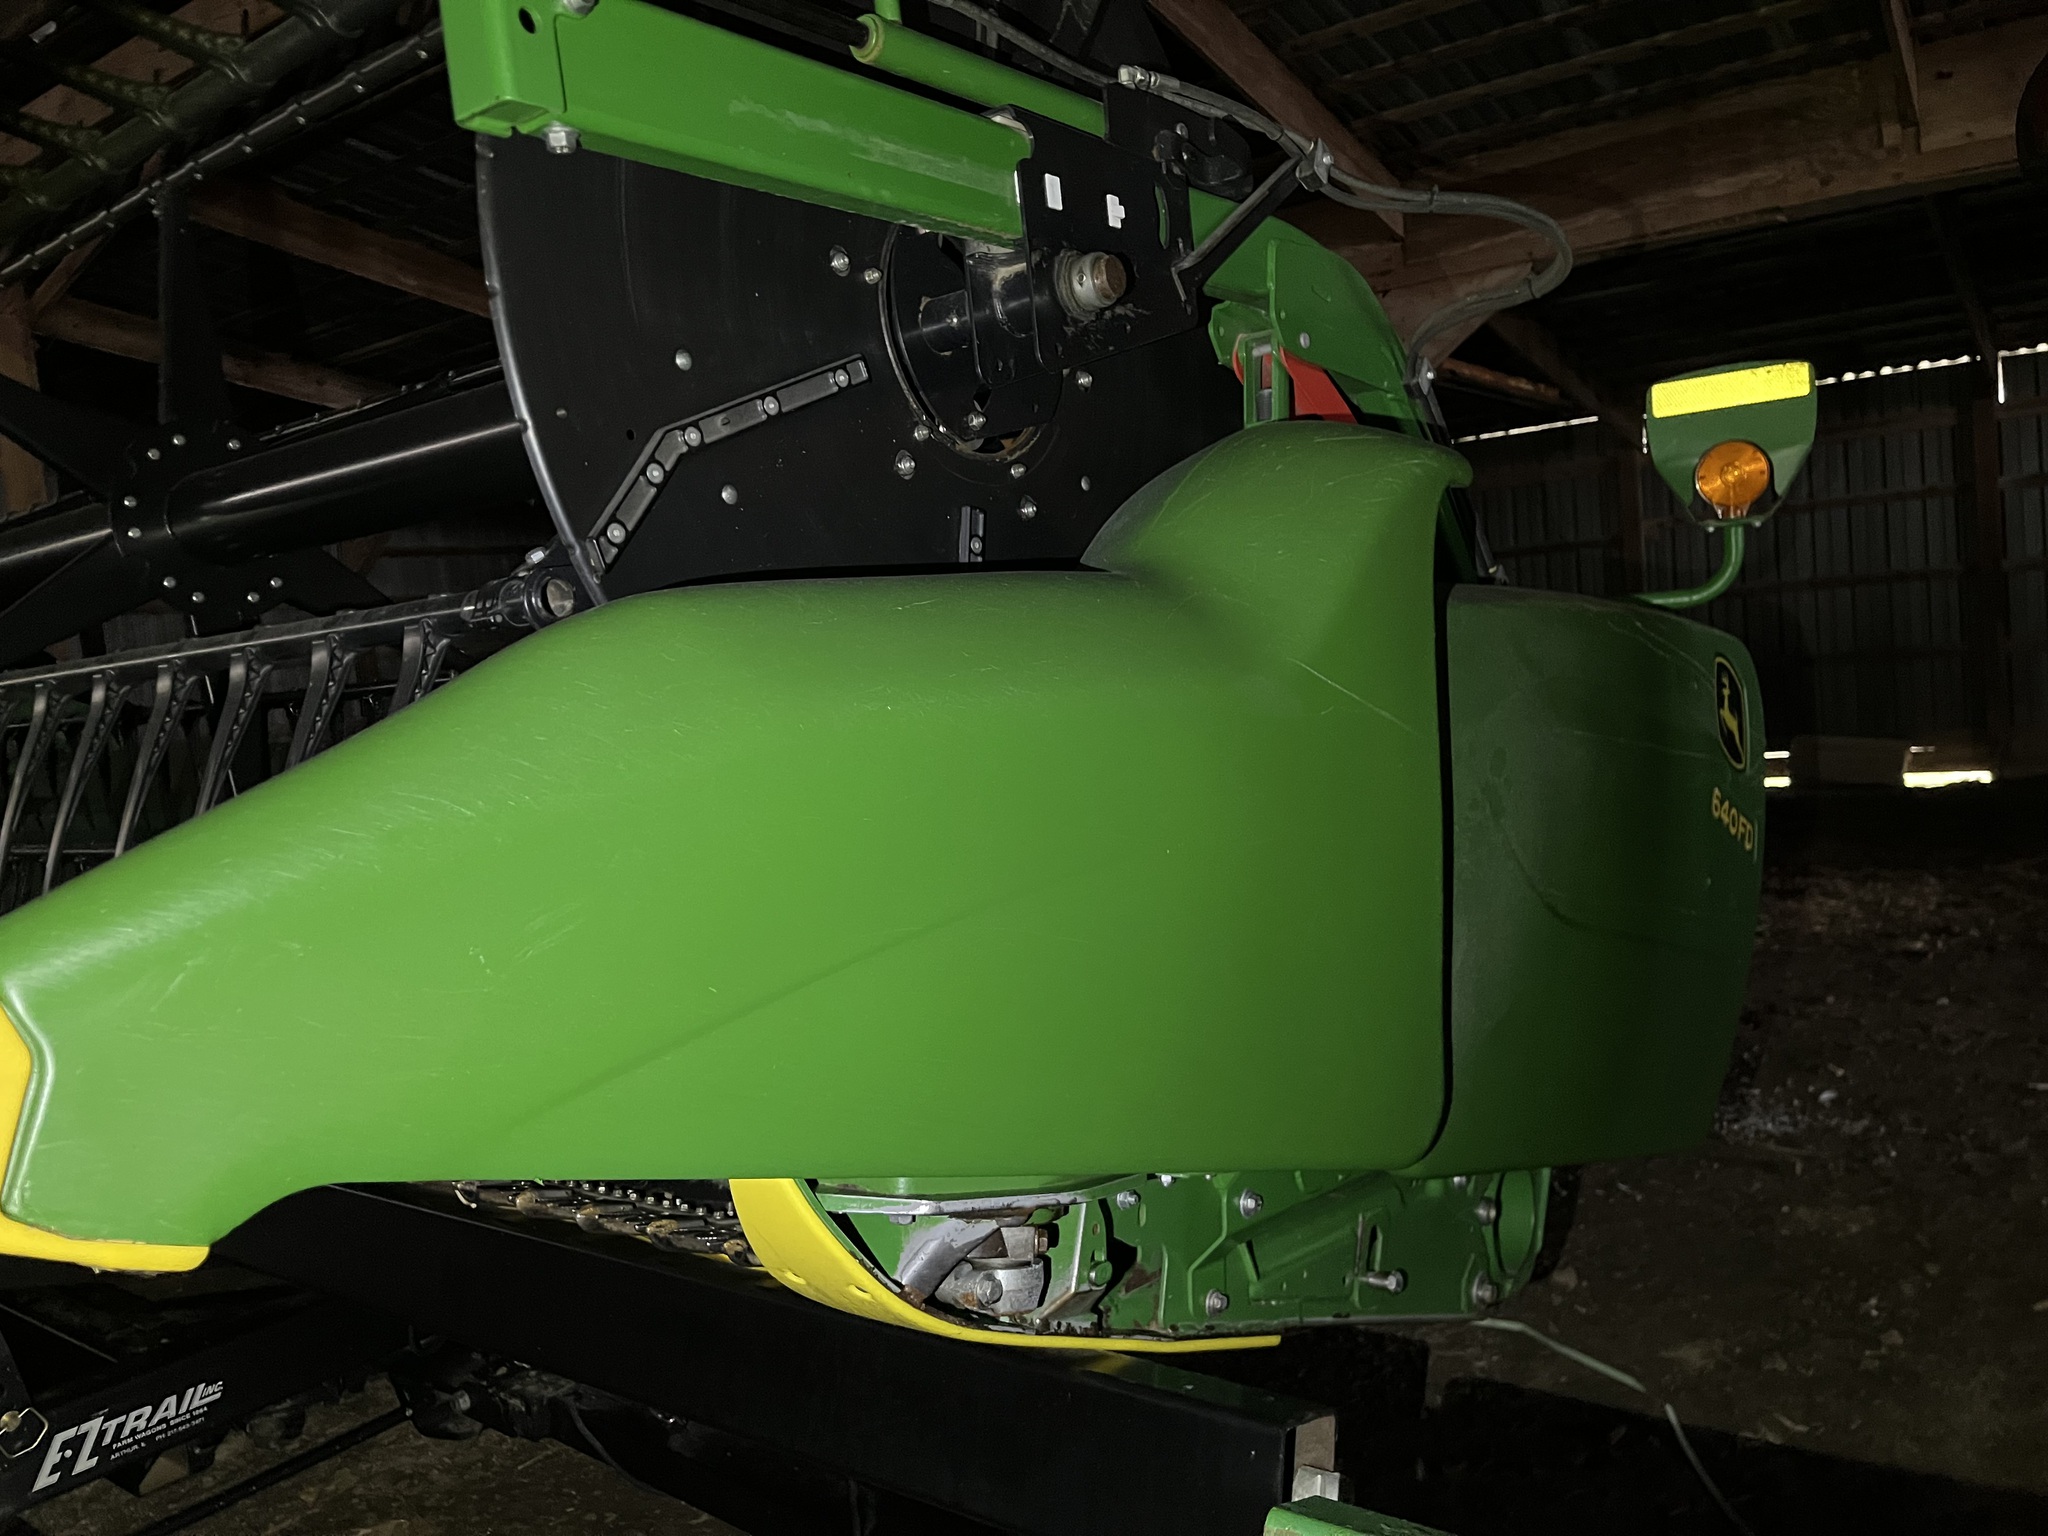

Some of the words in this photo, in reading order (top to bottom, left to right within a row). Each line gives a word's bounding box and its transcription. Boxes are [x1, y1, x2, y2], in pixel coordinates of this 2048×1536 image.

[1711, 786, 1754, 852] 640FD
[101, 1382, 222, 1446] TRAIL
[112, 1436, 134, 1450] FARM
[134, 1423, 167, 1440] WAGONS
[169, 1412, 191, 1426] SINCE
